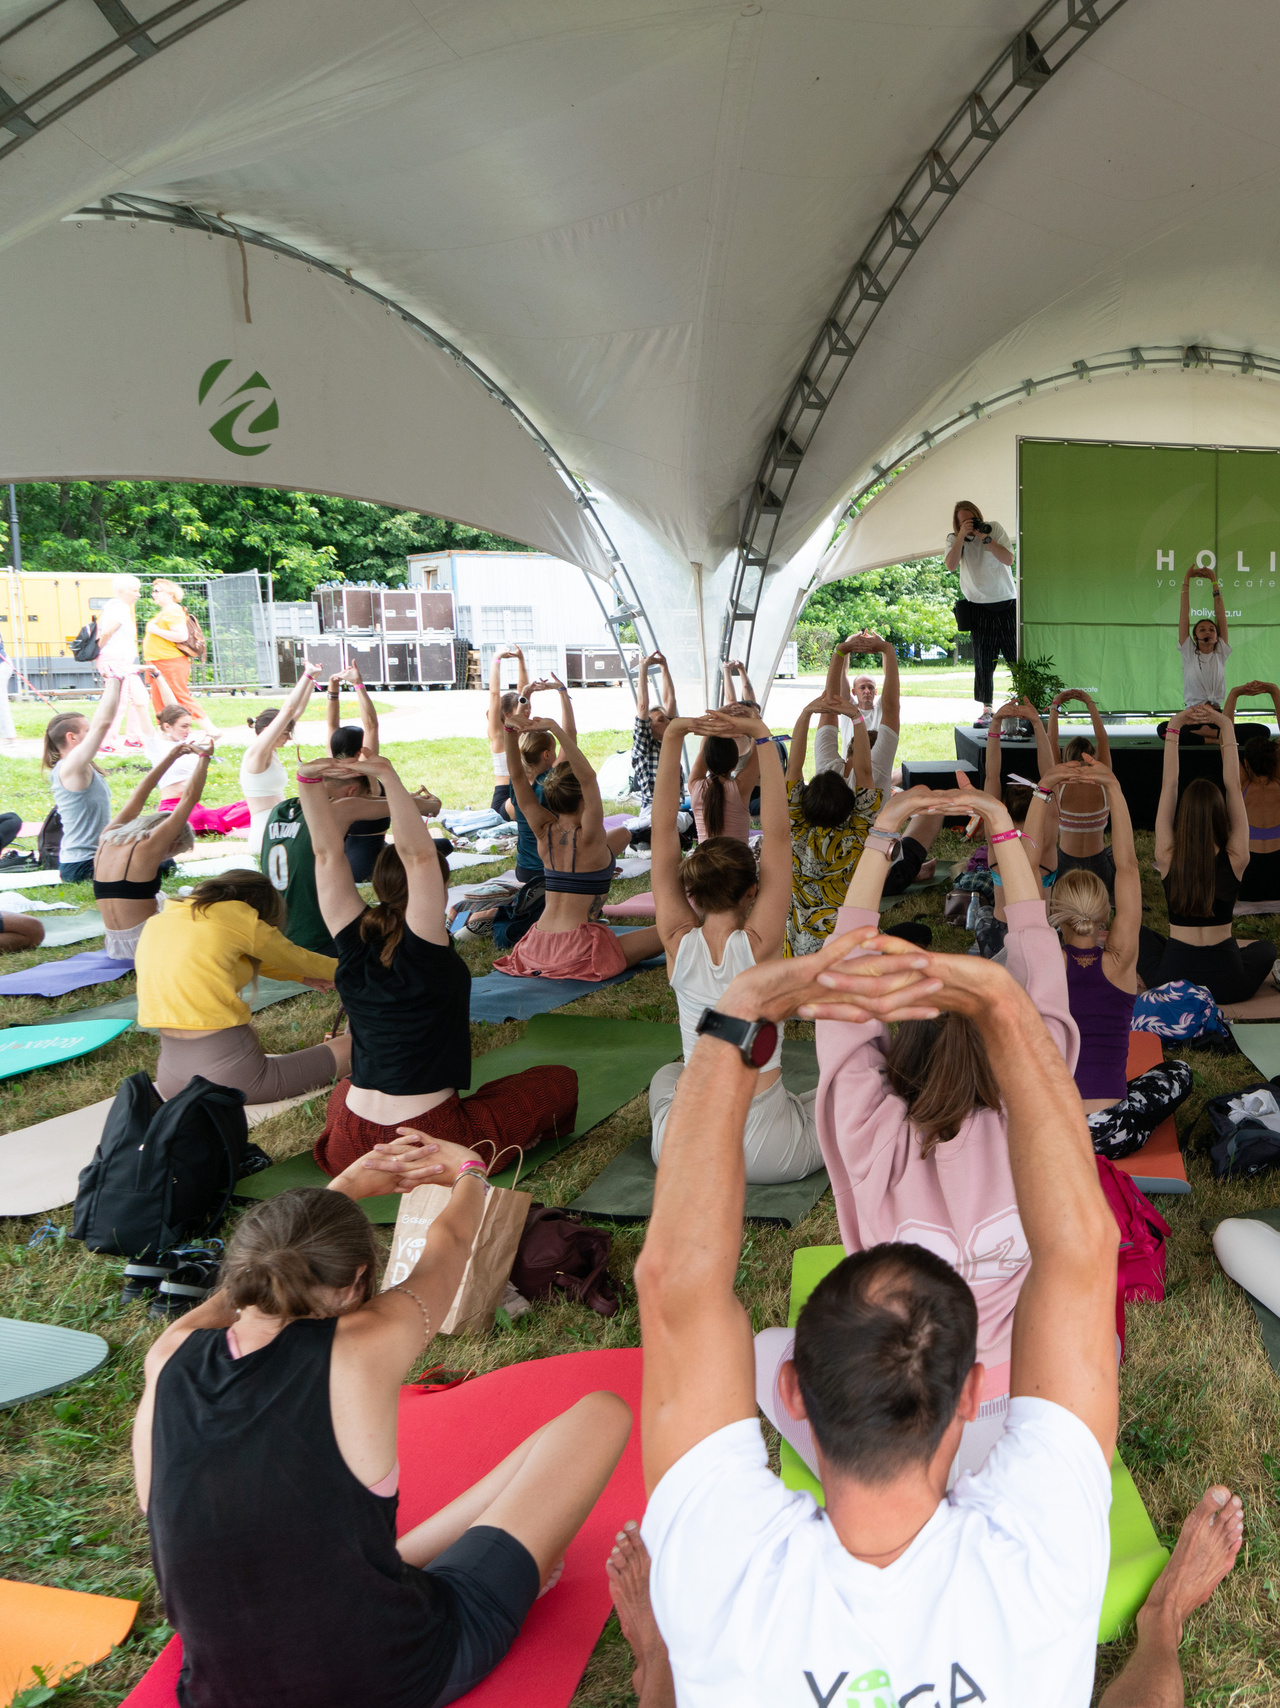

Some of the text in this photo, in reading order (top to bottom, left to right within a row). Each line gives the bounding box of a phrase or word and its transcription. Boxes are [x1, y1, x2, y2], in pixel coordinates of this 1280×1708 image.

[1156, 549, 1276, 572] HOLI
[1157, 579, 1204, 588] yoa
[1233, 579, 1276, 588] cafe
[1190, 608, 1242, 618] holiyoa.ru
[268, 821, 301, 840] TATUM
[268, 844, 289, 891] 0
